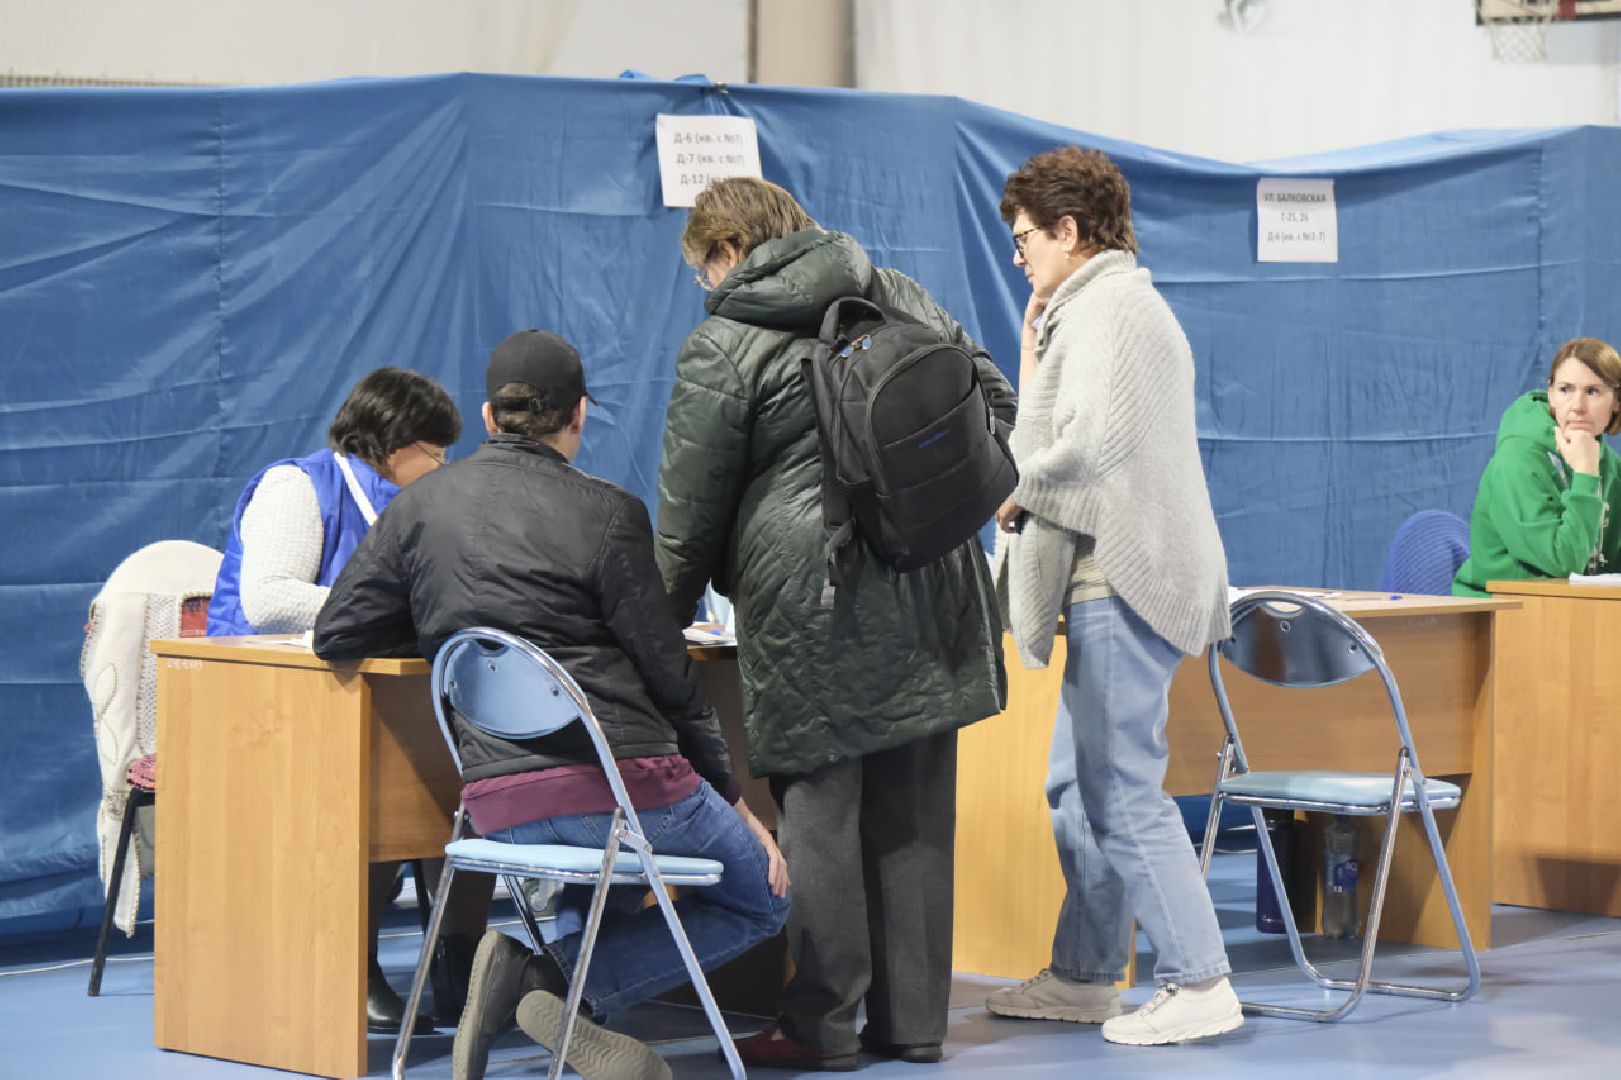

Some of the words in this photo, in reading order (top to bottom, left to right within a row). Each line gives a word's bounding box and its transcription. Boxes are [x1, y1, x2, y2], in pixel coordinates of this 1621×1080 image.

[673, 131, 692, 145] Д-6
[676, 153, 694, 166] Д-7
[680, 173, 705, 187] Д-12
